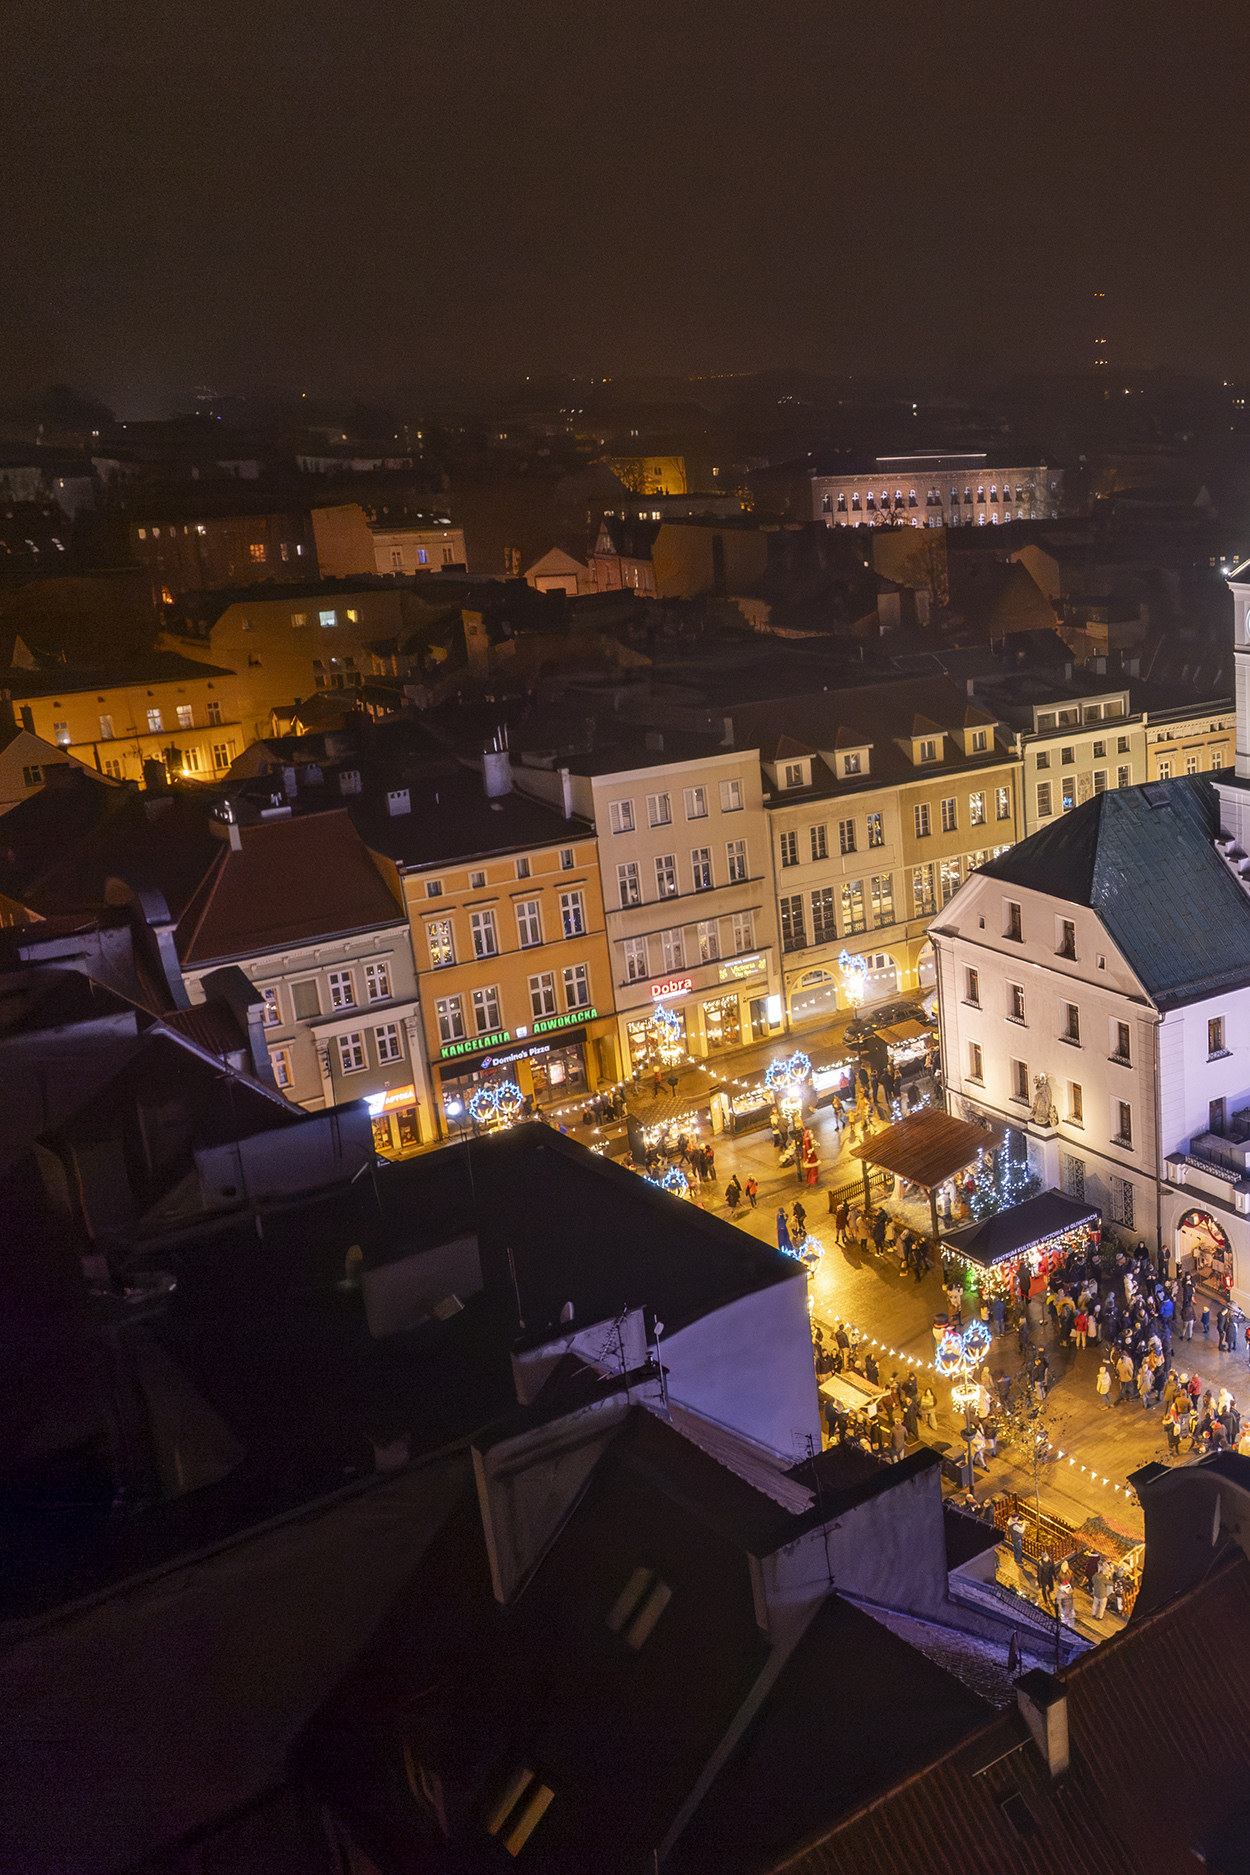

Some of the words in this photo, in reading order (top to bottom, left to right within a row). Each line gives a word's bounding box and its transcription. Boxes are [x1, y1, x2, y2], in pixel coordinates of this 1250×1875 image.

[651, 978, 692, 997] Dobra
[441, 1032, 511, 1058] KANCELARIA
[533, 1008, 598, 1034] ADWOKACKA
[492, 1050, 529, 1067] Domino's
[529, 1045, 551, 1057] Pizza
[991, 1249, 1017, 1265] CENTRUM
[1017, 1238, 1040, 1255] KULTURY
[1040, 1229, 1064, 1243] VICTORIA
[1063, 1224, 1070, 1232] W
